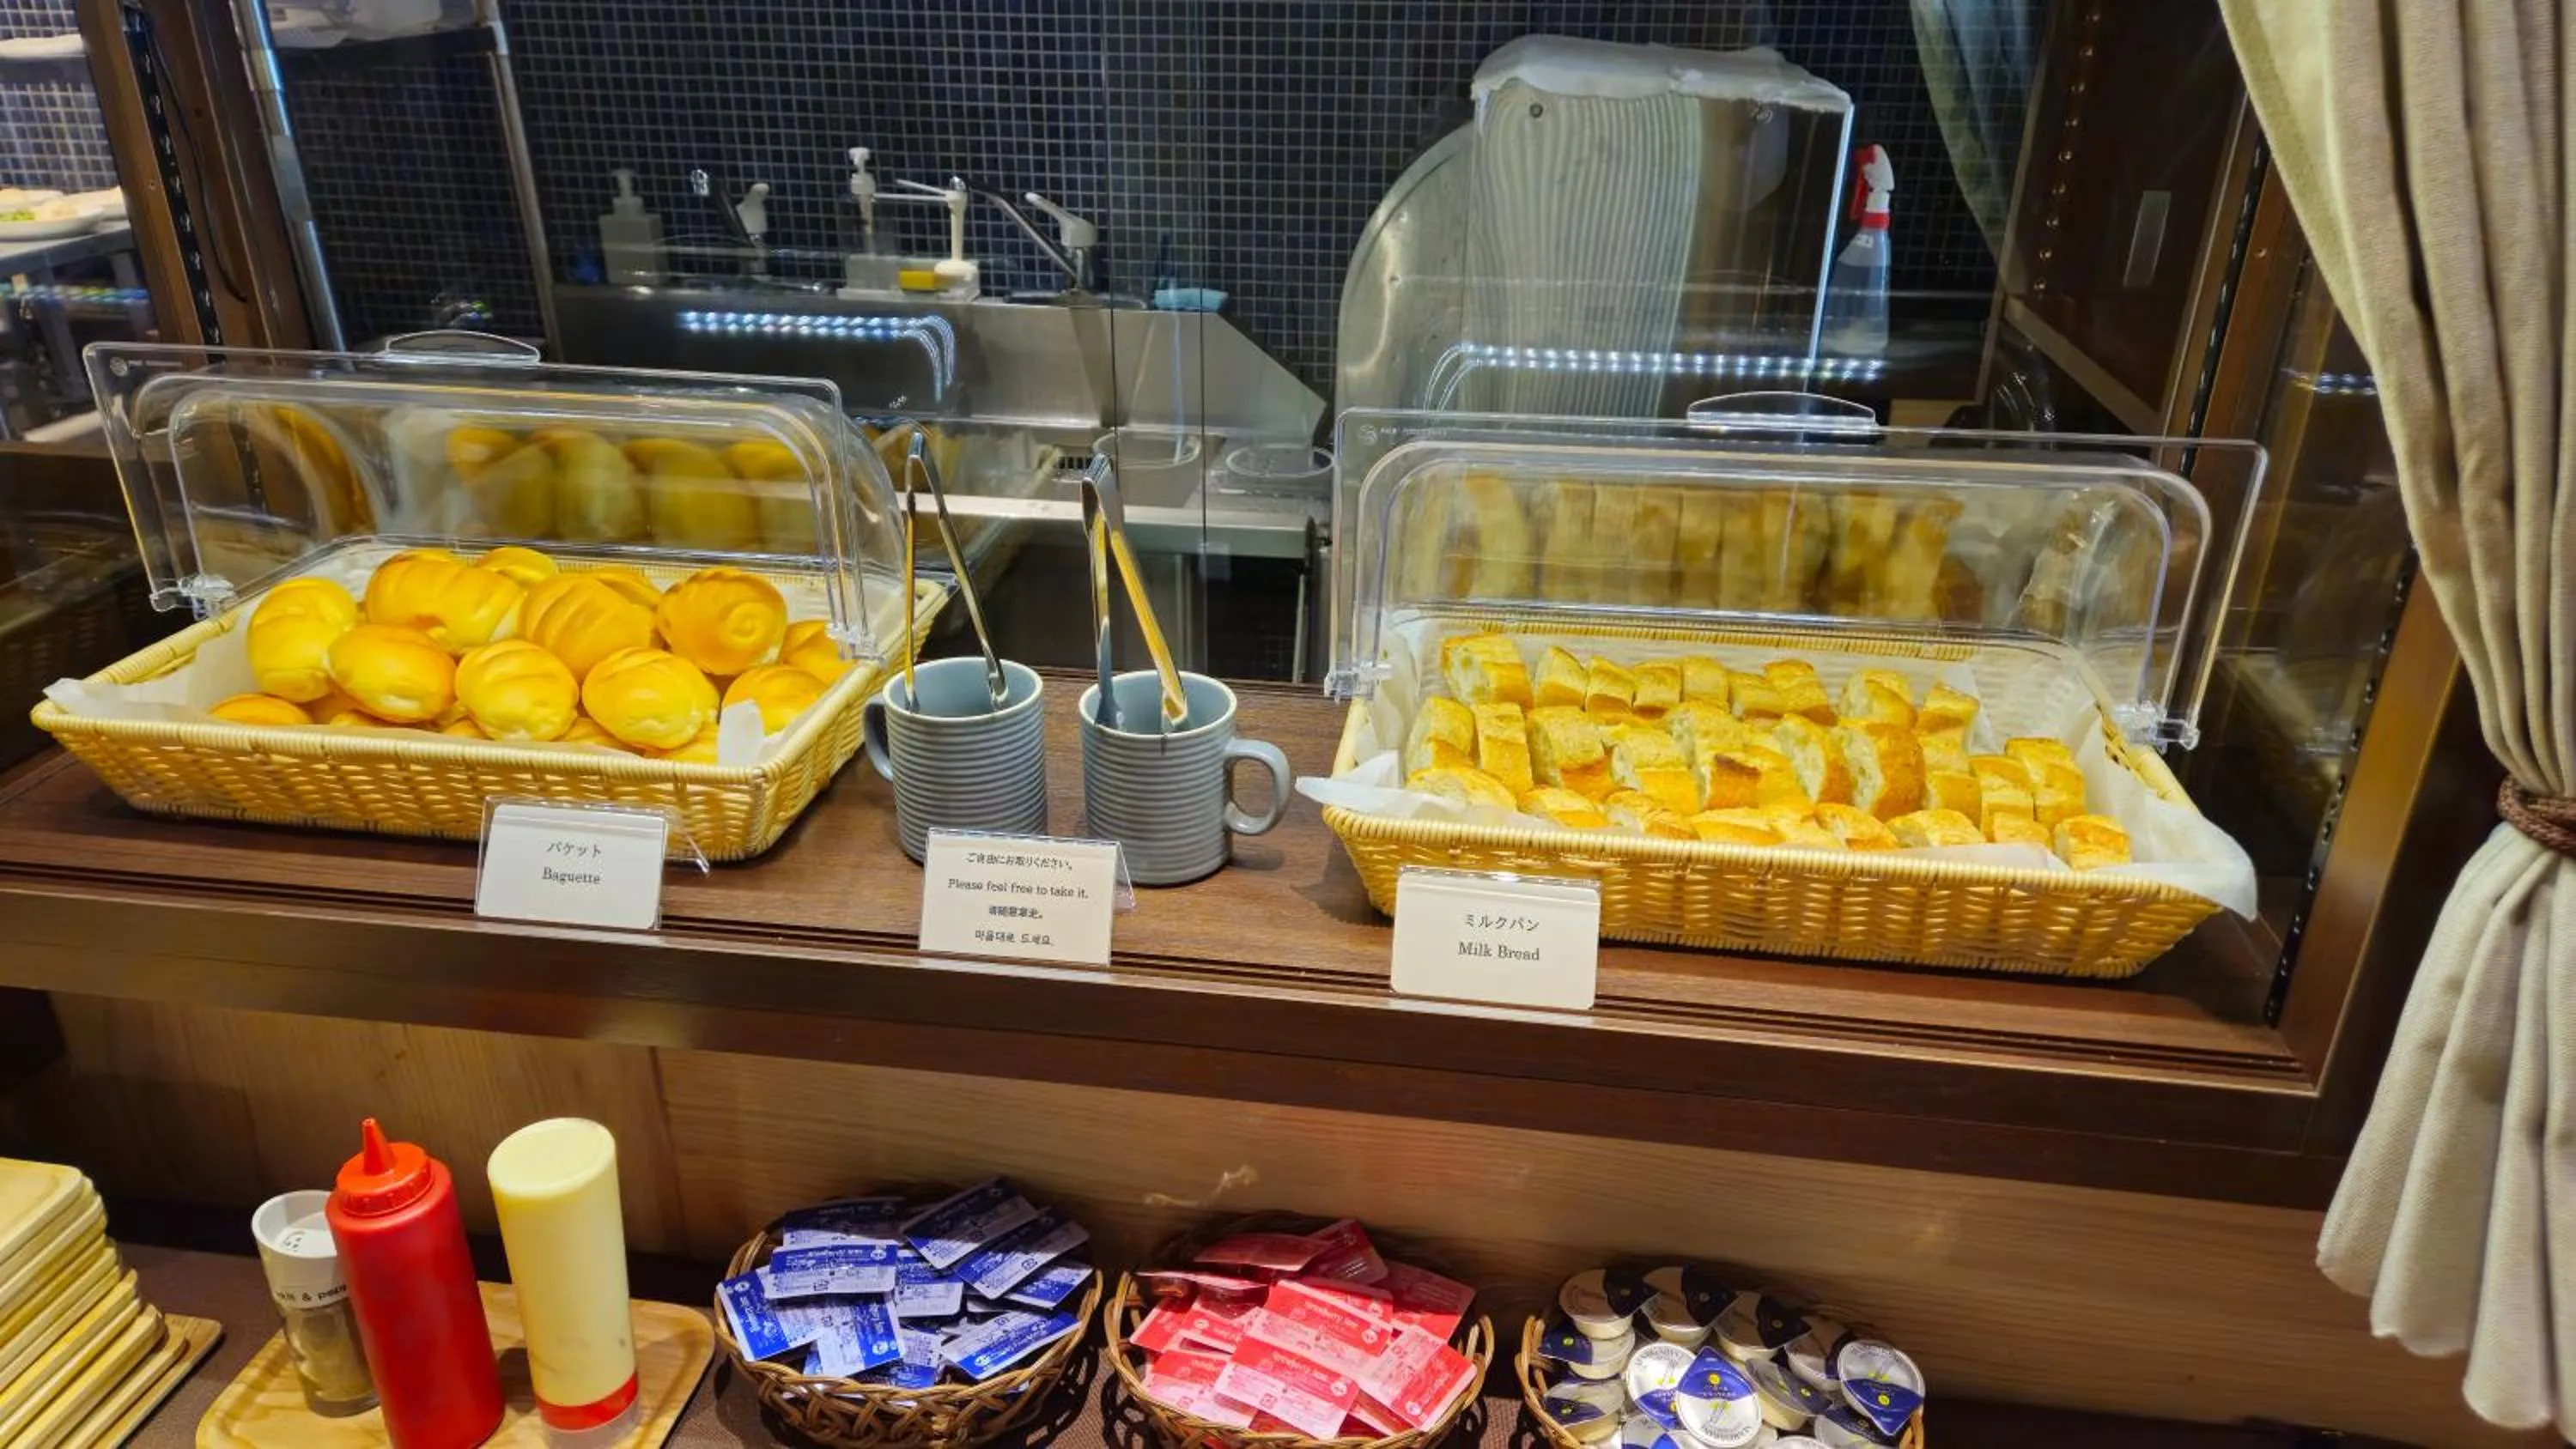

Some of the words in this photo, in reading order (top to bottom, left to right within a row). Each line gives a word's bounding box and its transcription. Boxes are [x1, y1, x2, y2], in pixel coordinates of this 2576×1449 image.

[541, 866, 601, 885] Baguette
[948, 878, 983, 890] Please
[987, 880, 1007, 892] feel
[1012, 882, 1032, 894] free
[1036, 885, 1048, 895] to
[1051, 886, 1073, 897] take
[1078, 888, 1089, 899] it.
[1465, 913, 1540, 931] ミルクパン
[1457, 941, 1492, 958] Milk
[1498, 944, 1540, 961] Bread
